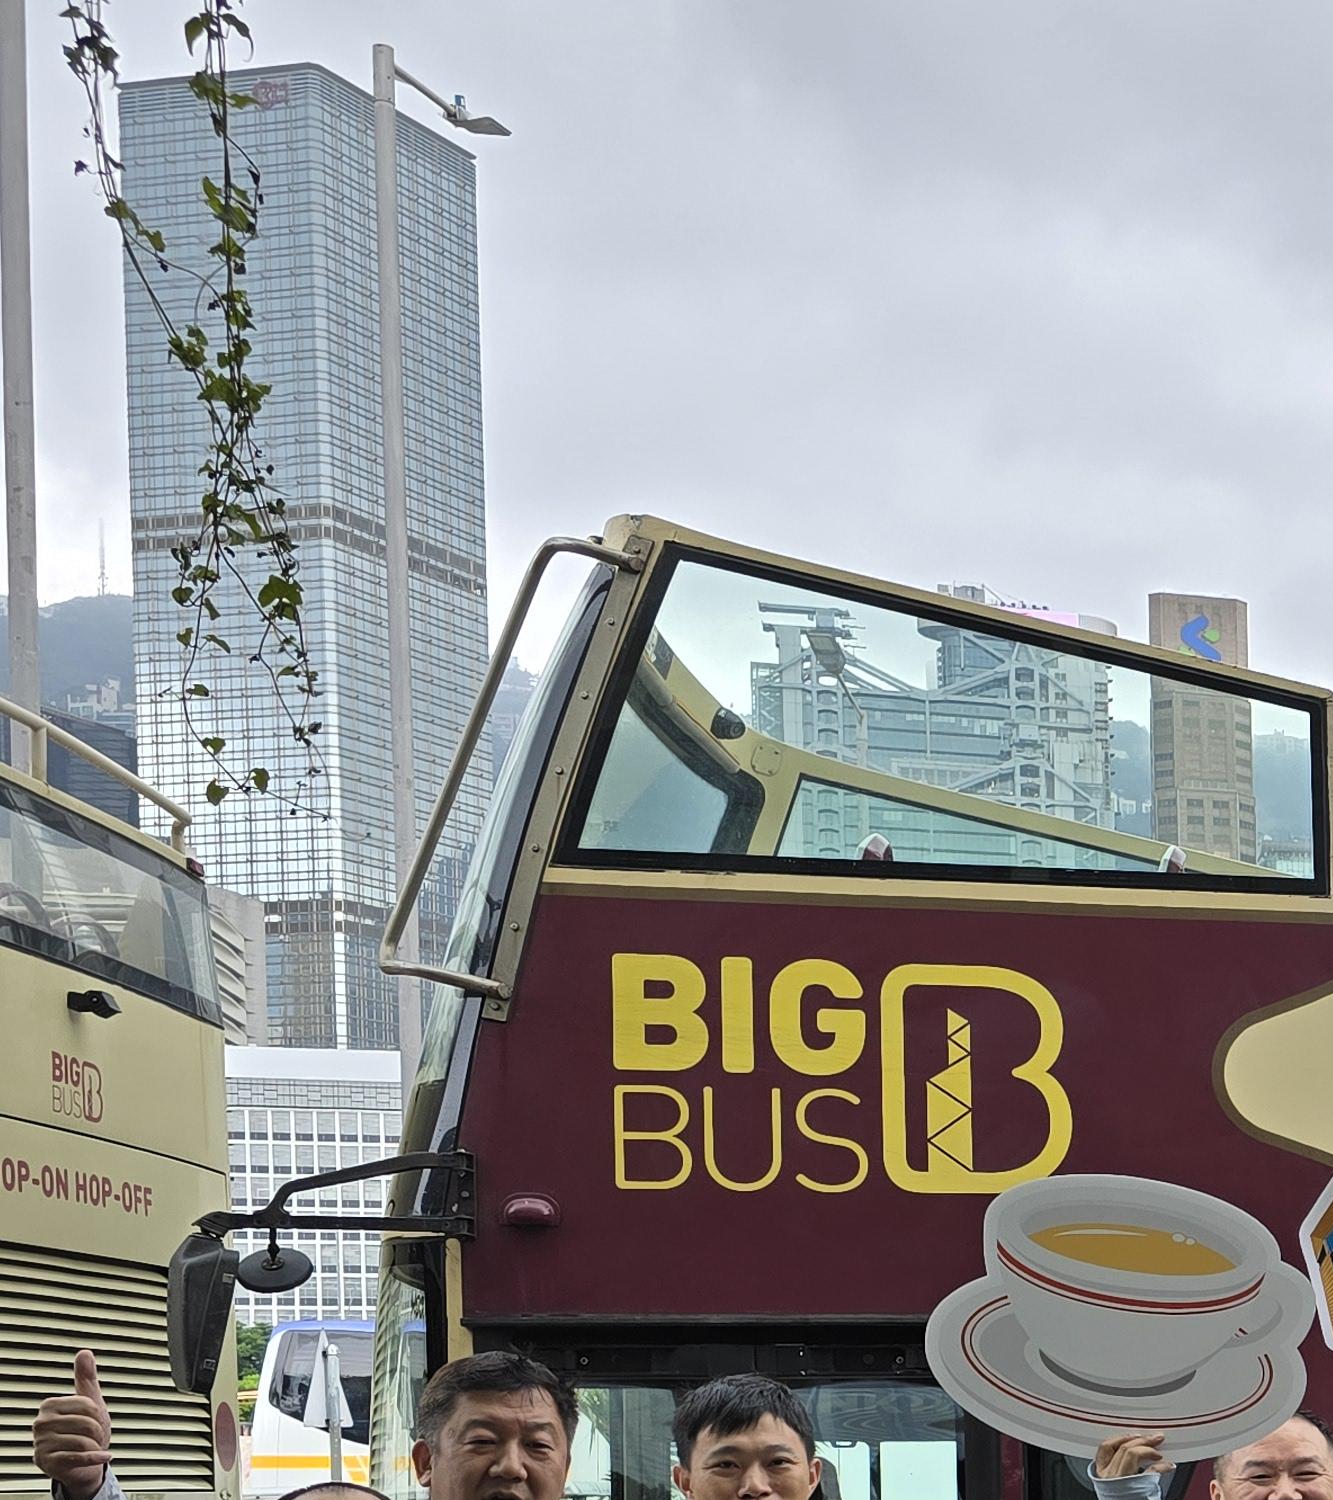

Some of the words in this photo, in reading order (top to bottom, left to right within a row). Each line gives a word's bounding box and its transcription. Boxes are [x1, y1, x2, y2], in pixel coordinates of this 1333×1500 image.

[610, 952, 867, 1076] BIG
[51, 1050, 80, 1087] BIG
[51, 1084, 82, 1118] BUS
[613, 1084, 869, 1193] BUS
[1, 1157, 69, 1201] OP-ON
[75, 1171, 153, 1217] HOP-OFF
